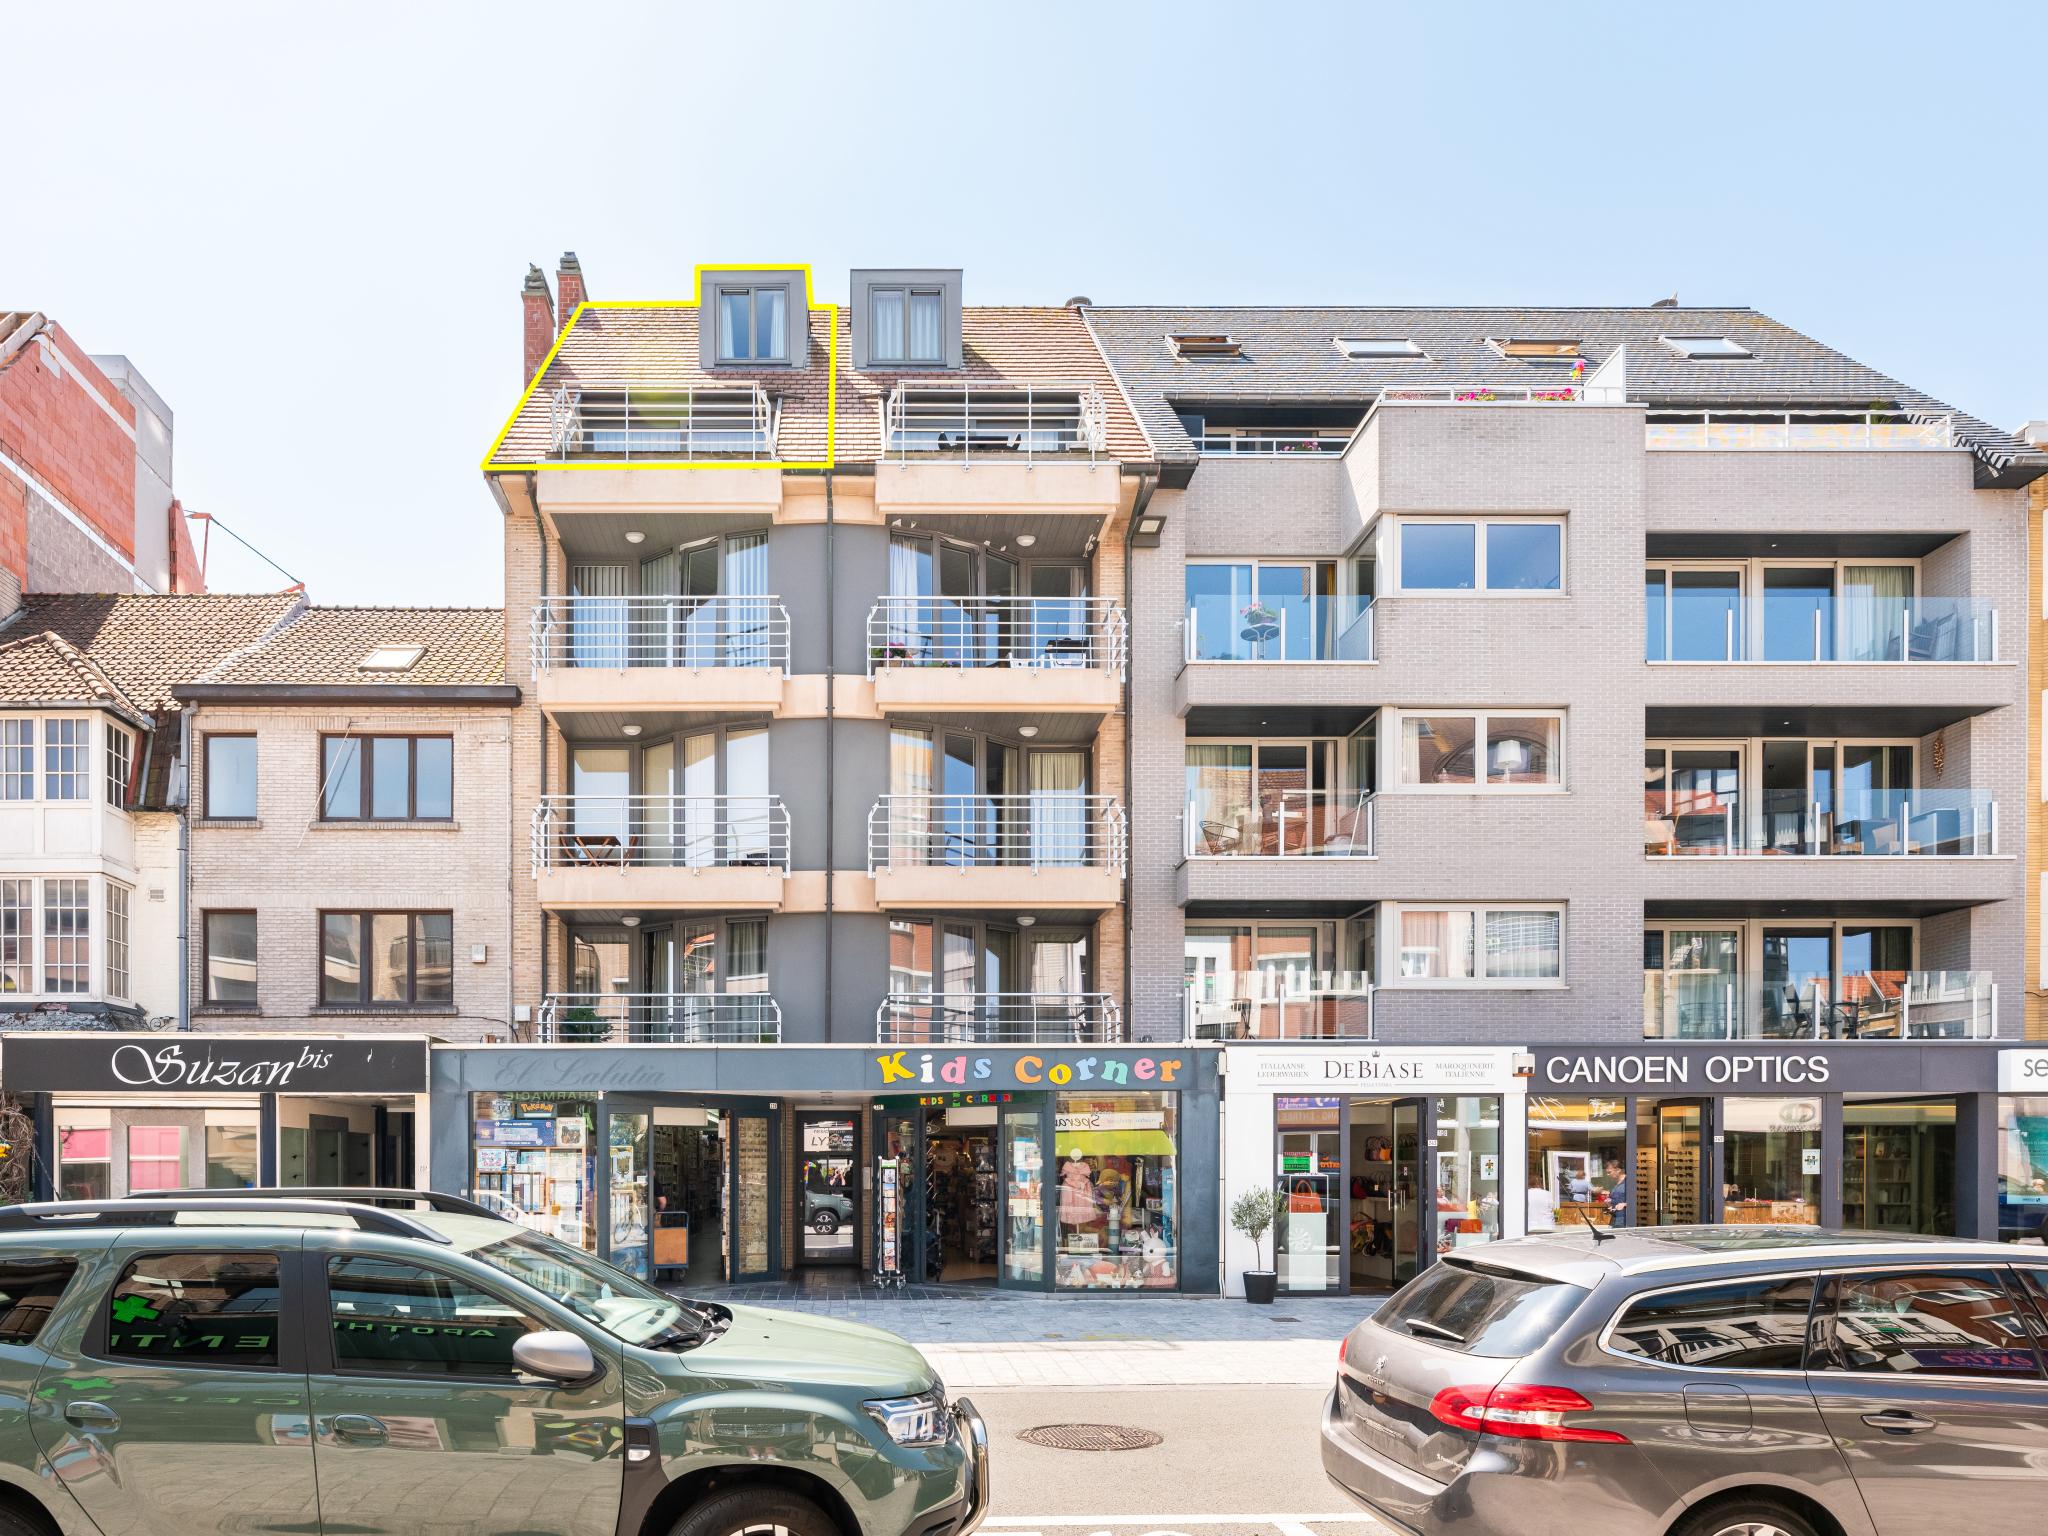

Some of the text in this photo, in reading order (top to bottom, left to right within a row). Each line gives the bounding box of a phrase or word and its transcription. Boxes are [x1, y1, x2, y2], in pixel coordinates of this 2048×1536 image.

[111, 1044, 332, 1086] Suzan bis
[876, 1051, 1182, 1085] Kids Corner
[1546, 1056, 1829, 1083] CANOEN OPTICS
